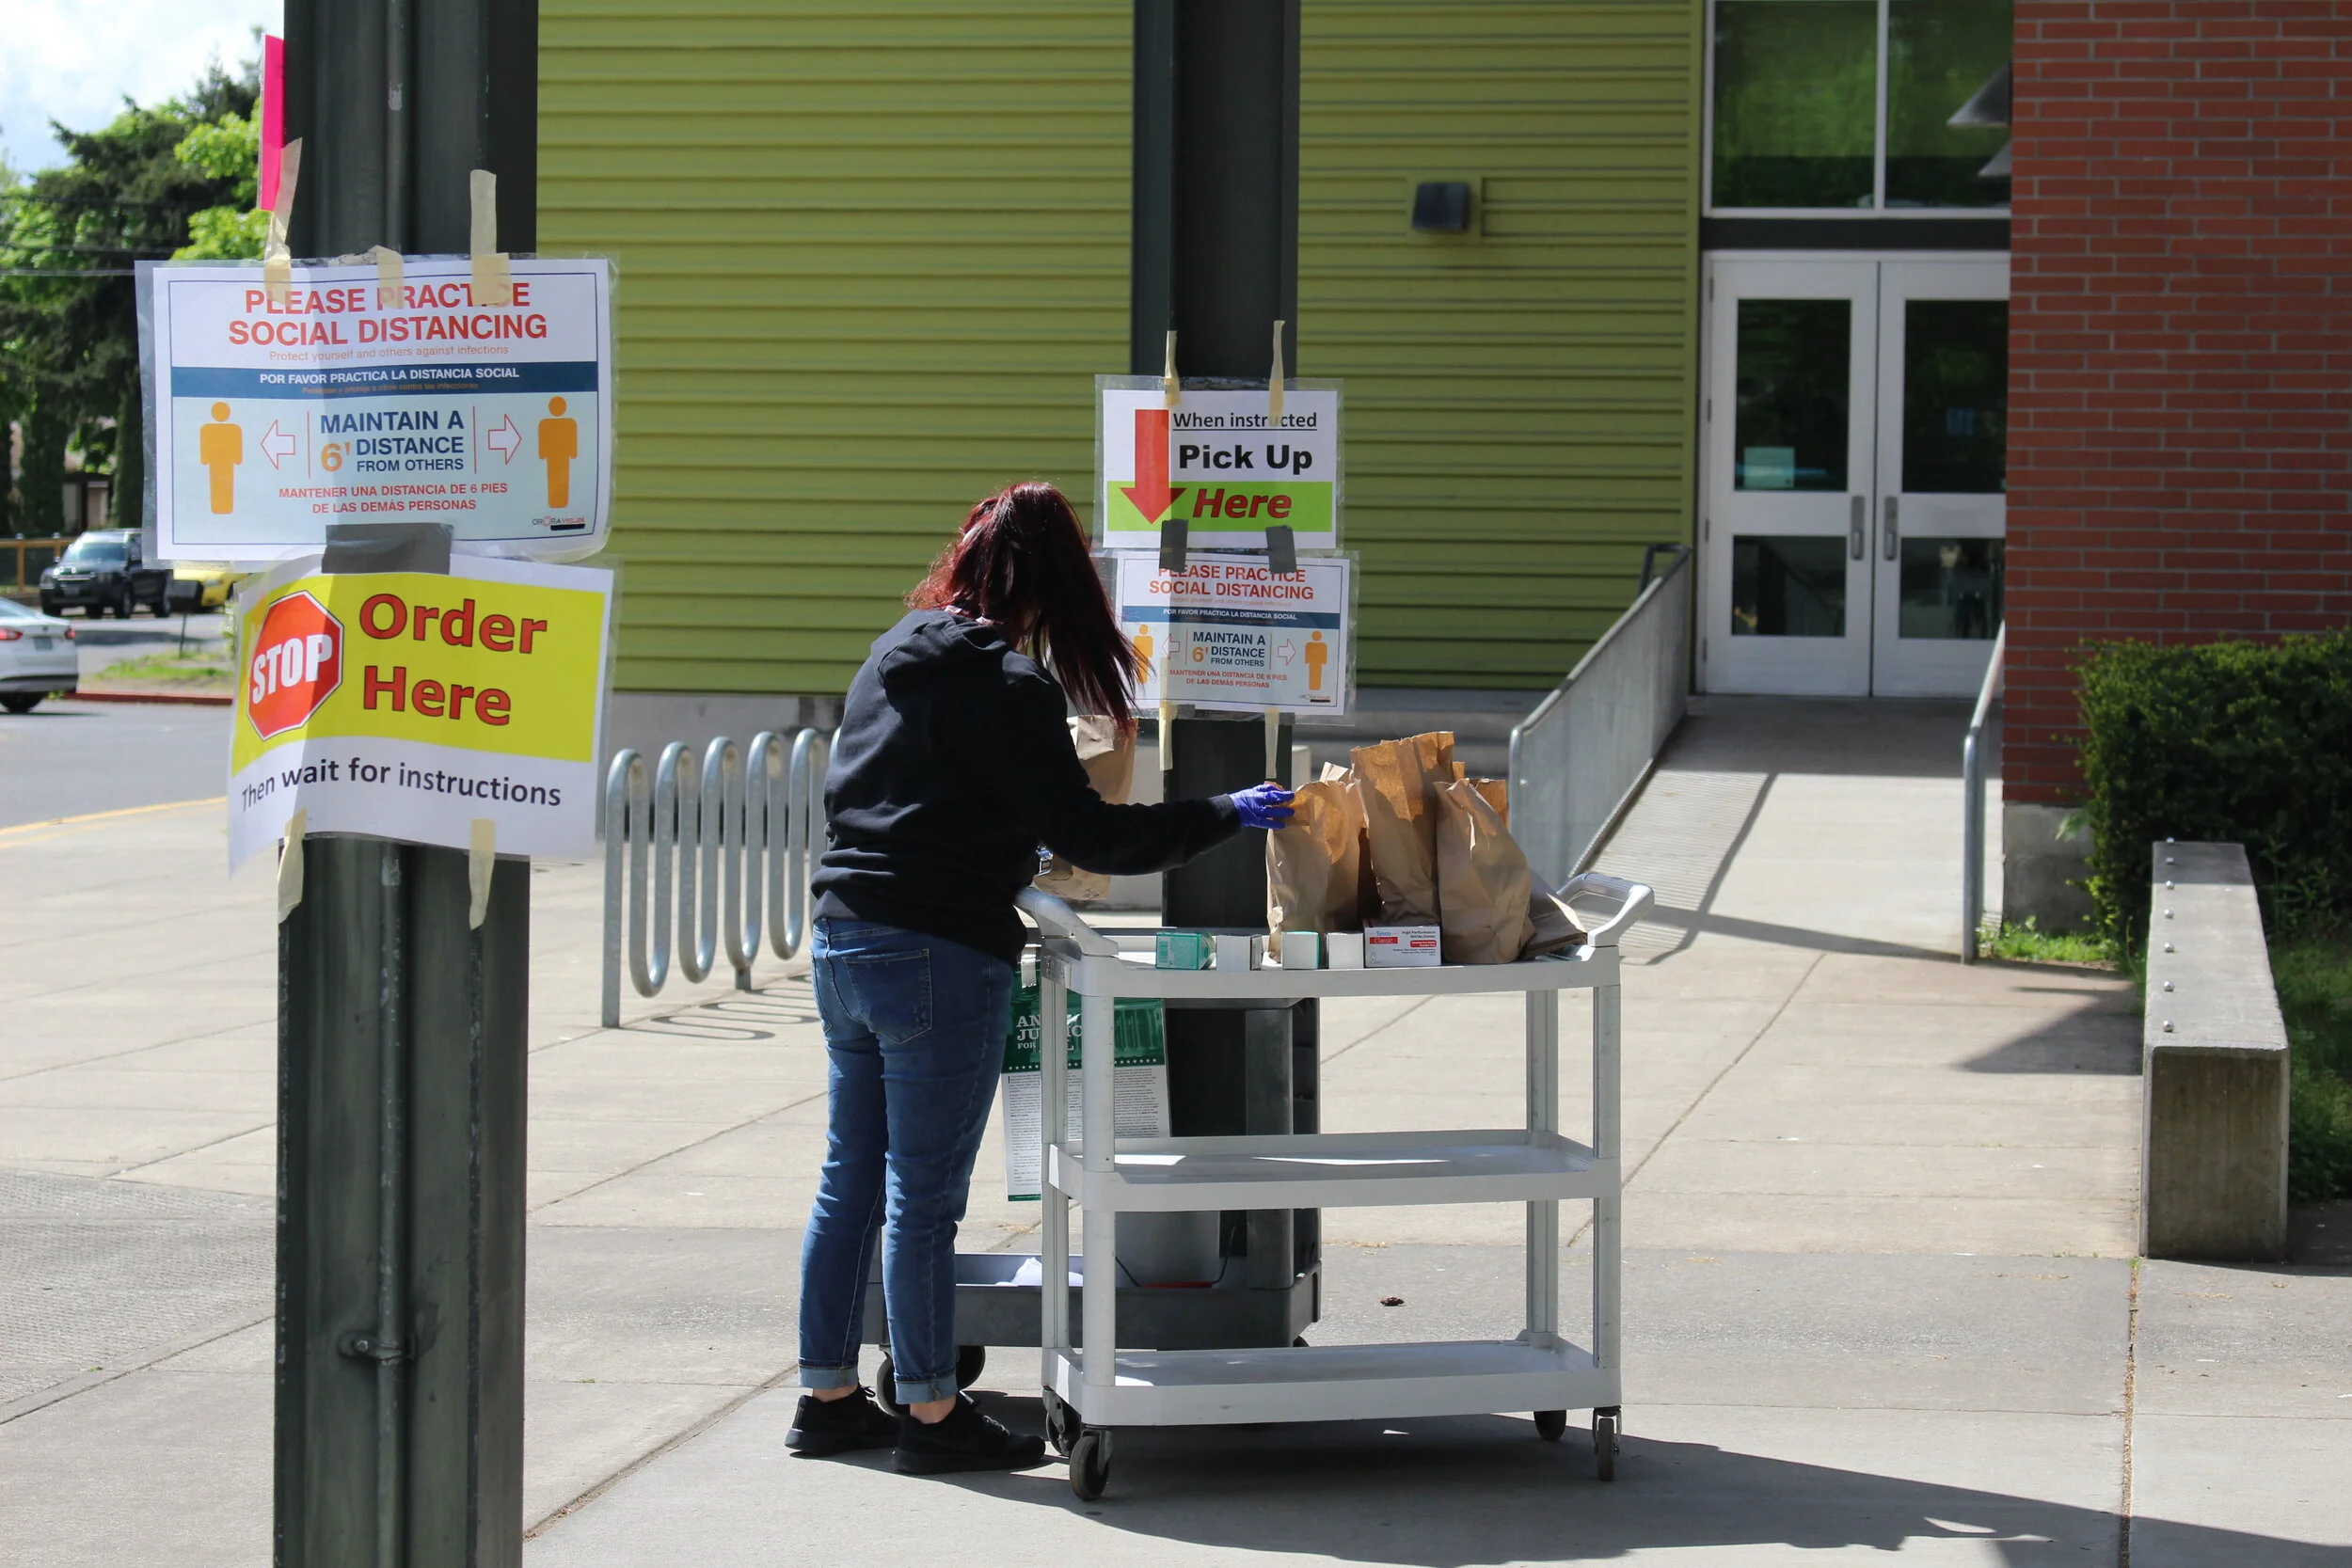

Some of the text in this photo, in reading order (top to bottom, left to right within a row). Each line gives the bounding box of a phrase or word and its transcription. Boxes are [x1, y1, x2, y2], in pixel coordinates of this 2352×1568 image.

[246, 282, 531, 314] PLEASE PRACTCE
[229, 313, 548, 346] SOCIAL DISTANCING
[269, 344, 509, 363] Protect yourself and others against infections
[260, 368, 519, 385] POR FAVOR PRACTICA LA DISTANCIA SOCIAL
[321, 410, 464, 434] MAINTAIN A
[1173, 412, 1224, 427] When
[357, 436, 464, 455] DISTANCE
[357, 458, 464, 471] FROM OTHERS
[1180, 445, 1312, 475] Pick Up
[278, 483, 508, 498] MANTENER UNA DISTANCIA DE 6 PIES
[312, 499, 476, 514] DE LAS DEMÁS PERSONAS
[1192, 488, 1292, 518] Here
[1149, 580, 1313, 599] SOCIAL DISTANCING
[358, 593, 548, 654] Order
[1193, 631, 1266, 645] MAINTAIN A
[1211, 646, 1264, 658] DISTANCE
[252, 634, 333, 705] STOP
[1234, 658, 1264, 667] OTHERS
[363, 665, 511, 726] Here
[242, 757, 562, 813] Then wait for instructions
[1017, 1016, 1041, 1027] AN
